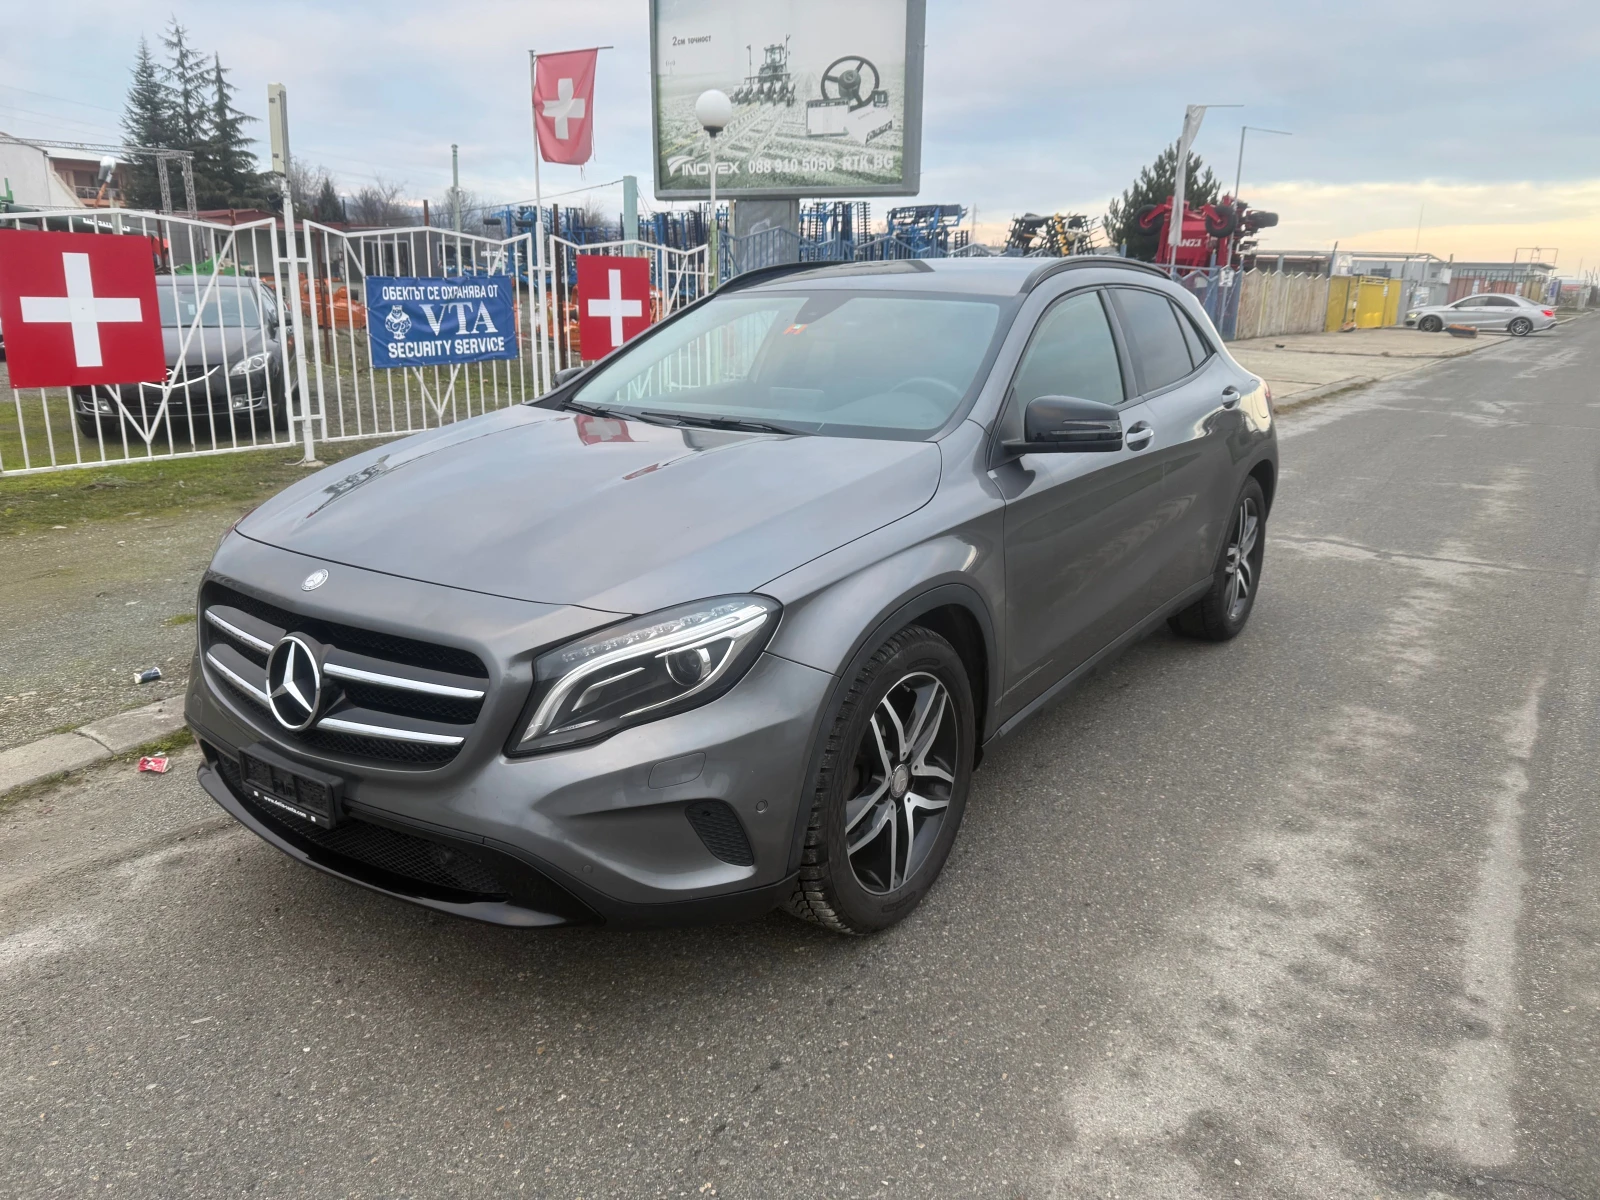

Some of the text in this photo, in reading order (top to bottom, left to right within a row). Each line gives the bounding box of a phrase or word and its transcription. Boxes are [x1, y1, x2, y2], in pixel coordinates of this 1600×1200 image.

[687, 35, 711, 44] точност
[748, 158, 834, 174] 088 910 5050
[842, 155, 894, 171] RTK.BG
[382, 285, 498, 300] ОБЕКТЪТ СЕ ОХРАНЯВА ОТ
[419, 301, 499, 336] VTA
[388, 337, 505, 358] SECURITY SERVICE
